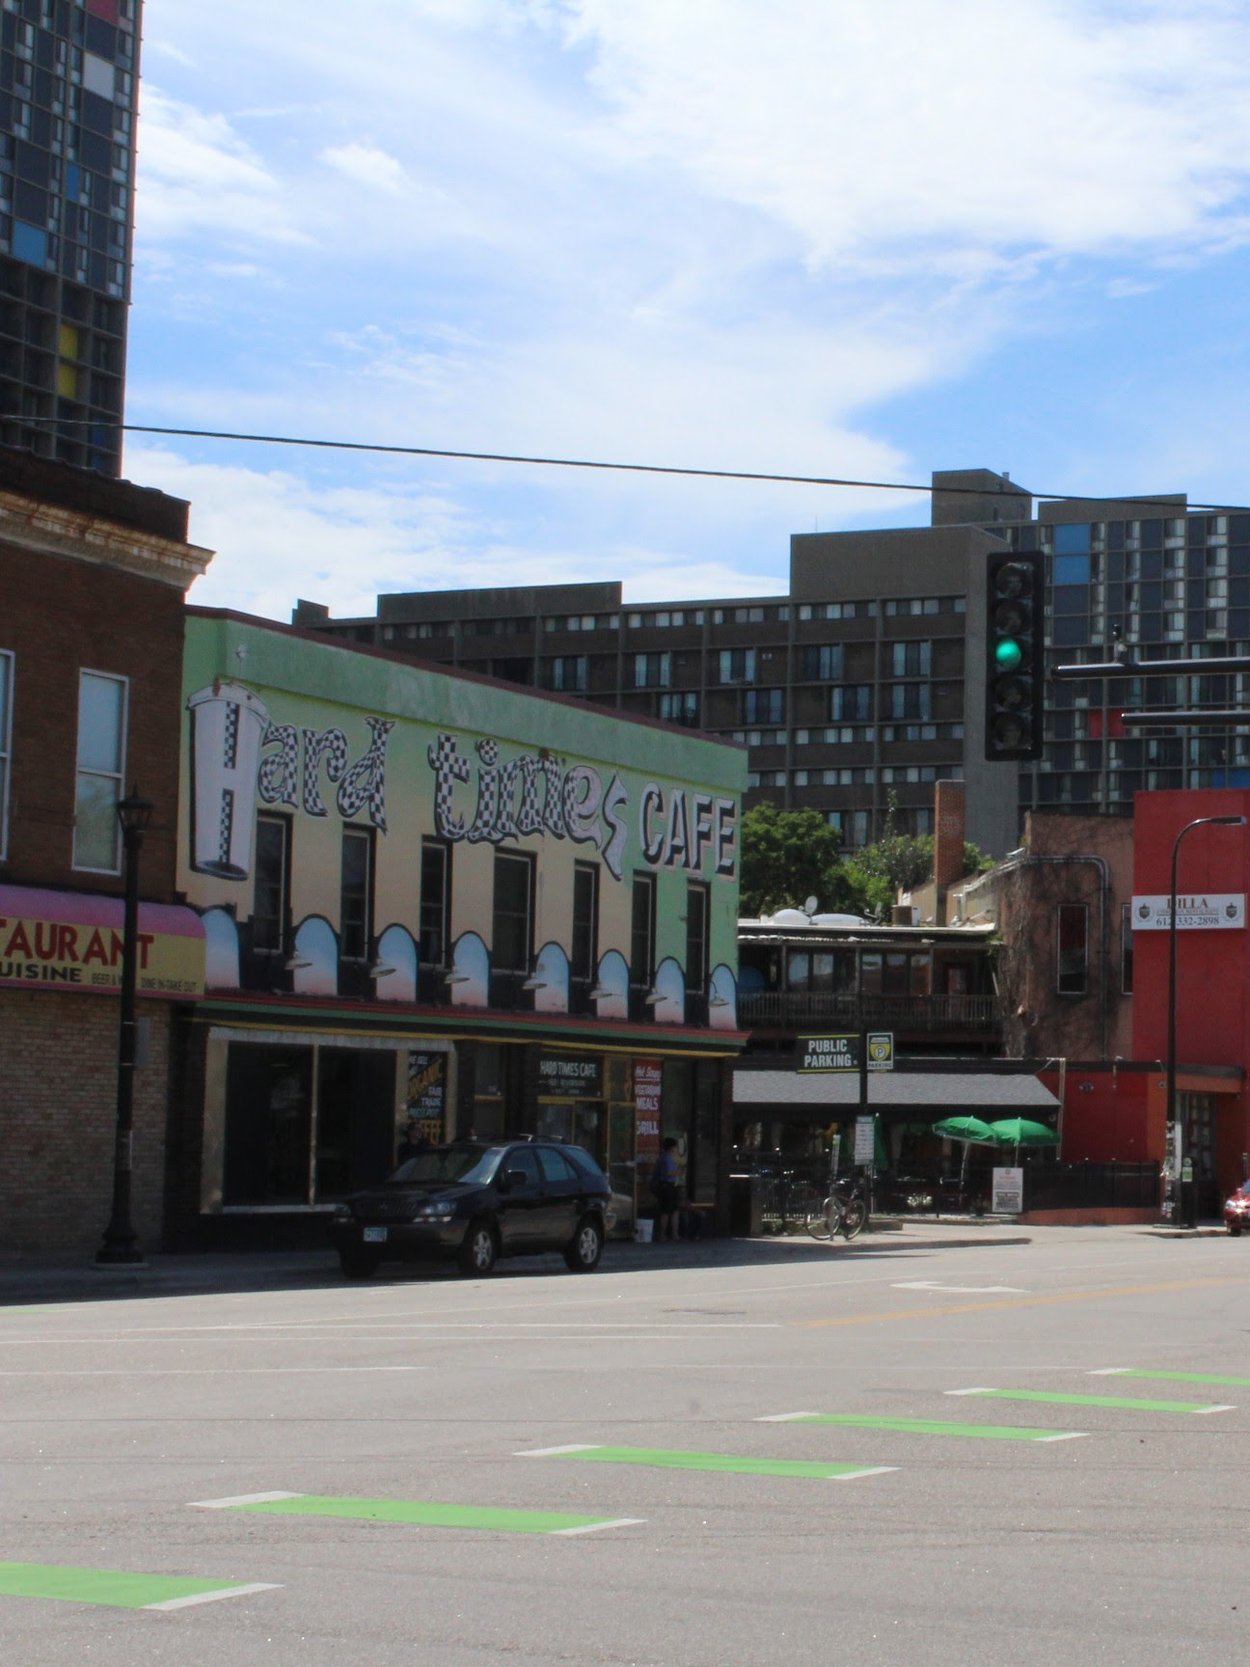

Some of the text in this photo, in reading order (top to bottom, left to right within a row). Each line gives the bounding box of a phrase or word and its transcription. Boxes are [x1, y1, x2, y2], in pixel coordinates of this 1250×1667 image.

[185, 680, 738, 882] Hard times CAFE
[808, 1039, 848, 1053] PUBLIC
[804, 1054, 852, 1068] PARKING
[540, 1060, 597, 1078] HARD TIMES CAFE
[637, 1097, 658, 1110] MEALS
